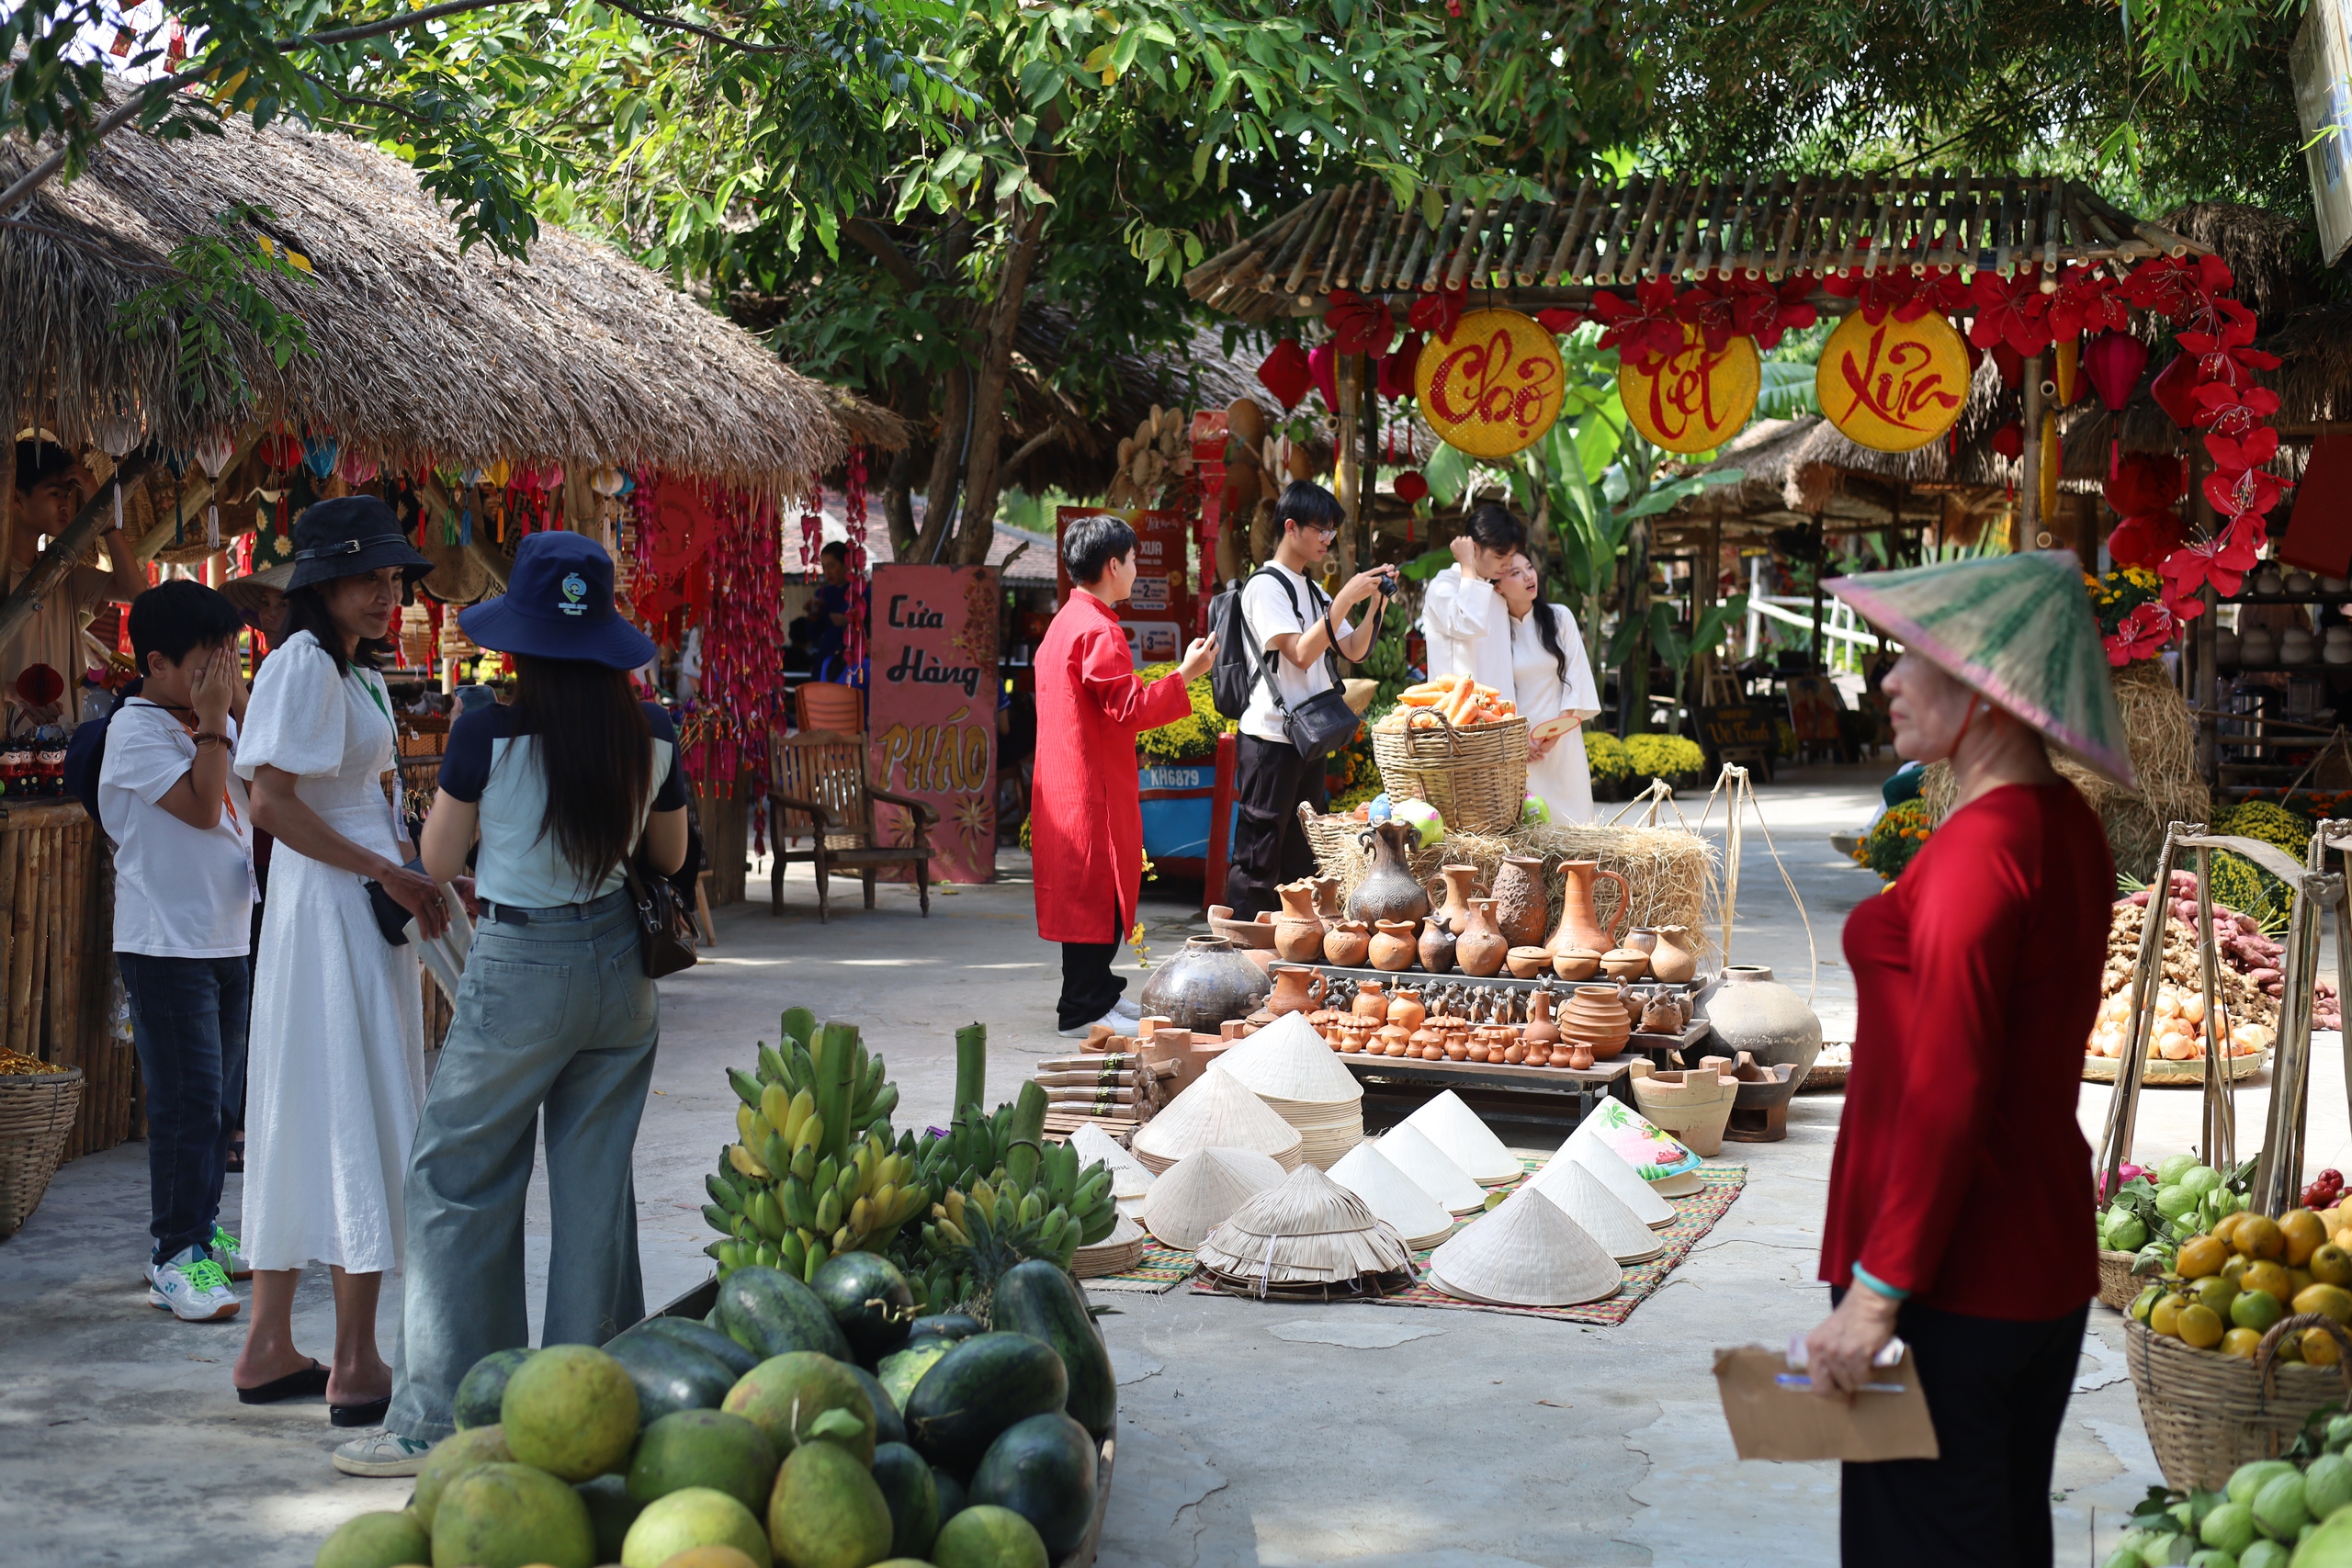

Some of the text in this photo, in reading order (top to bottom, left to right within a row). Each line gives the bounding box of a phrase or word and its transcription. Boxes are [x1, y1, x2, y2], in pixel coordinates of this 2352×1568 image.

[1430, 329, 1559, 438] Chợ
[1839, 324, 1960, 432] Xưa
[1143, 584, 1150, 598] 2
[888, 594, 944, 629] Cửa
[1147, 636, 1154, 650] 3
[887, 646, 982, 698] Hàng
[876, 705, 989, 794] PHÁO
[1150, 768, 1200, 787] KH6879
